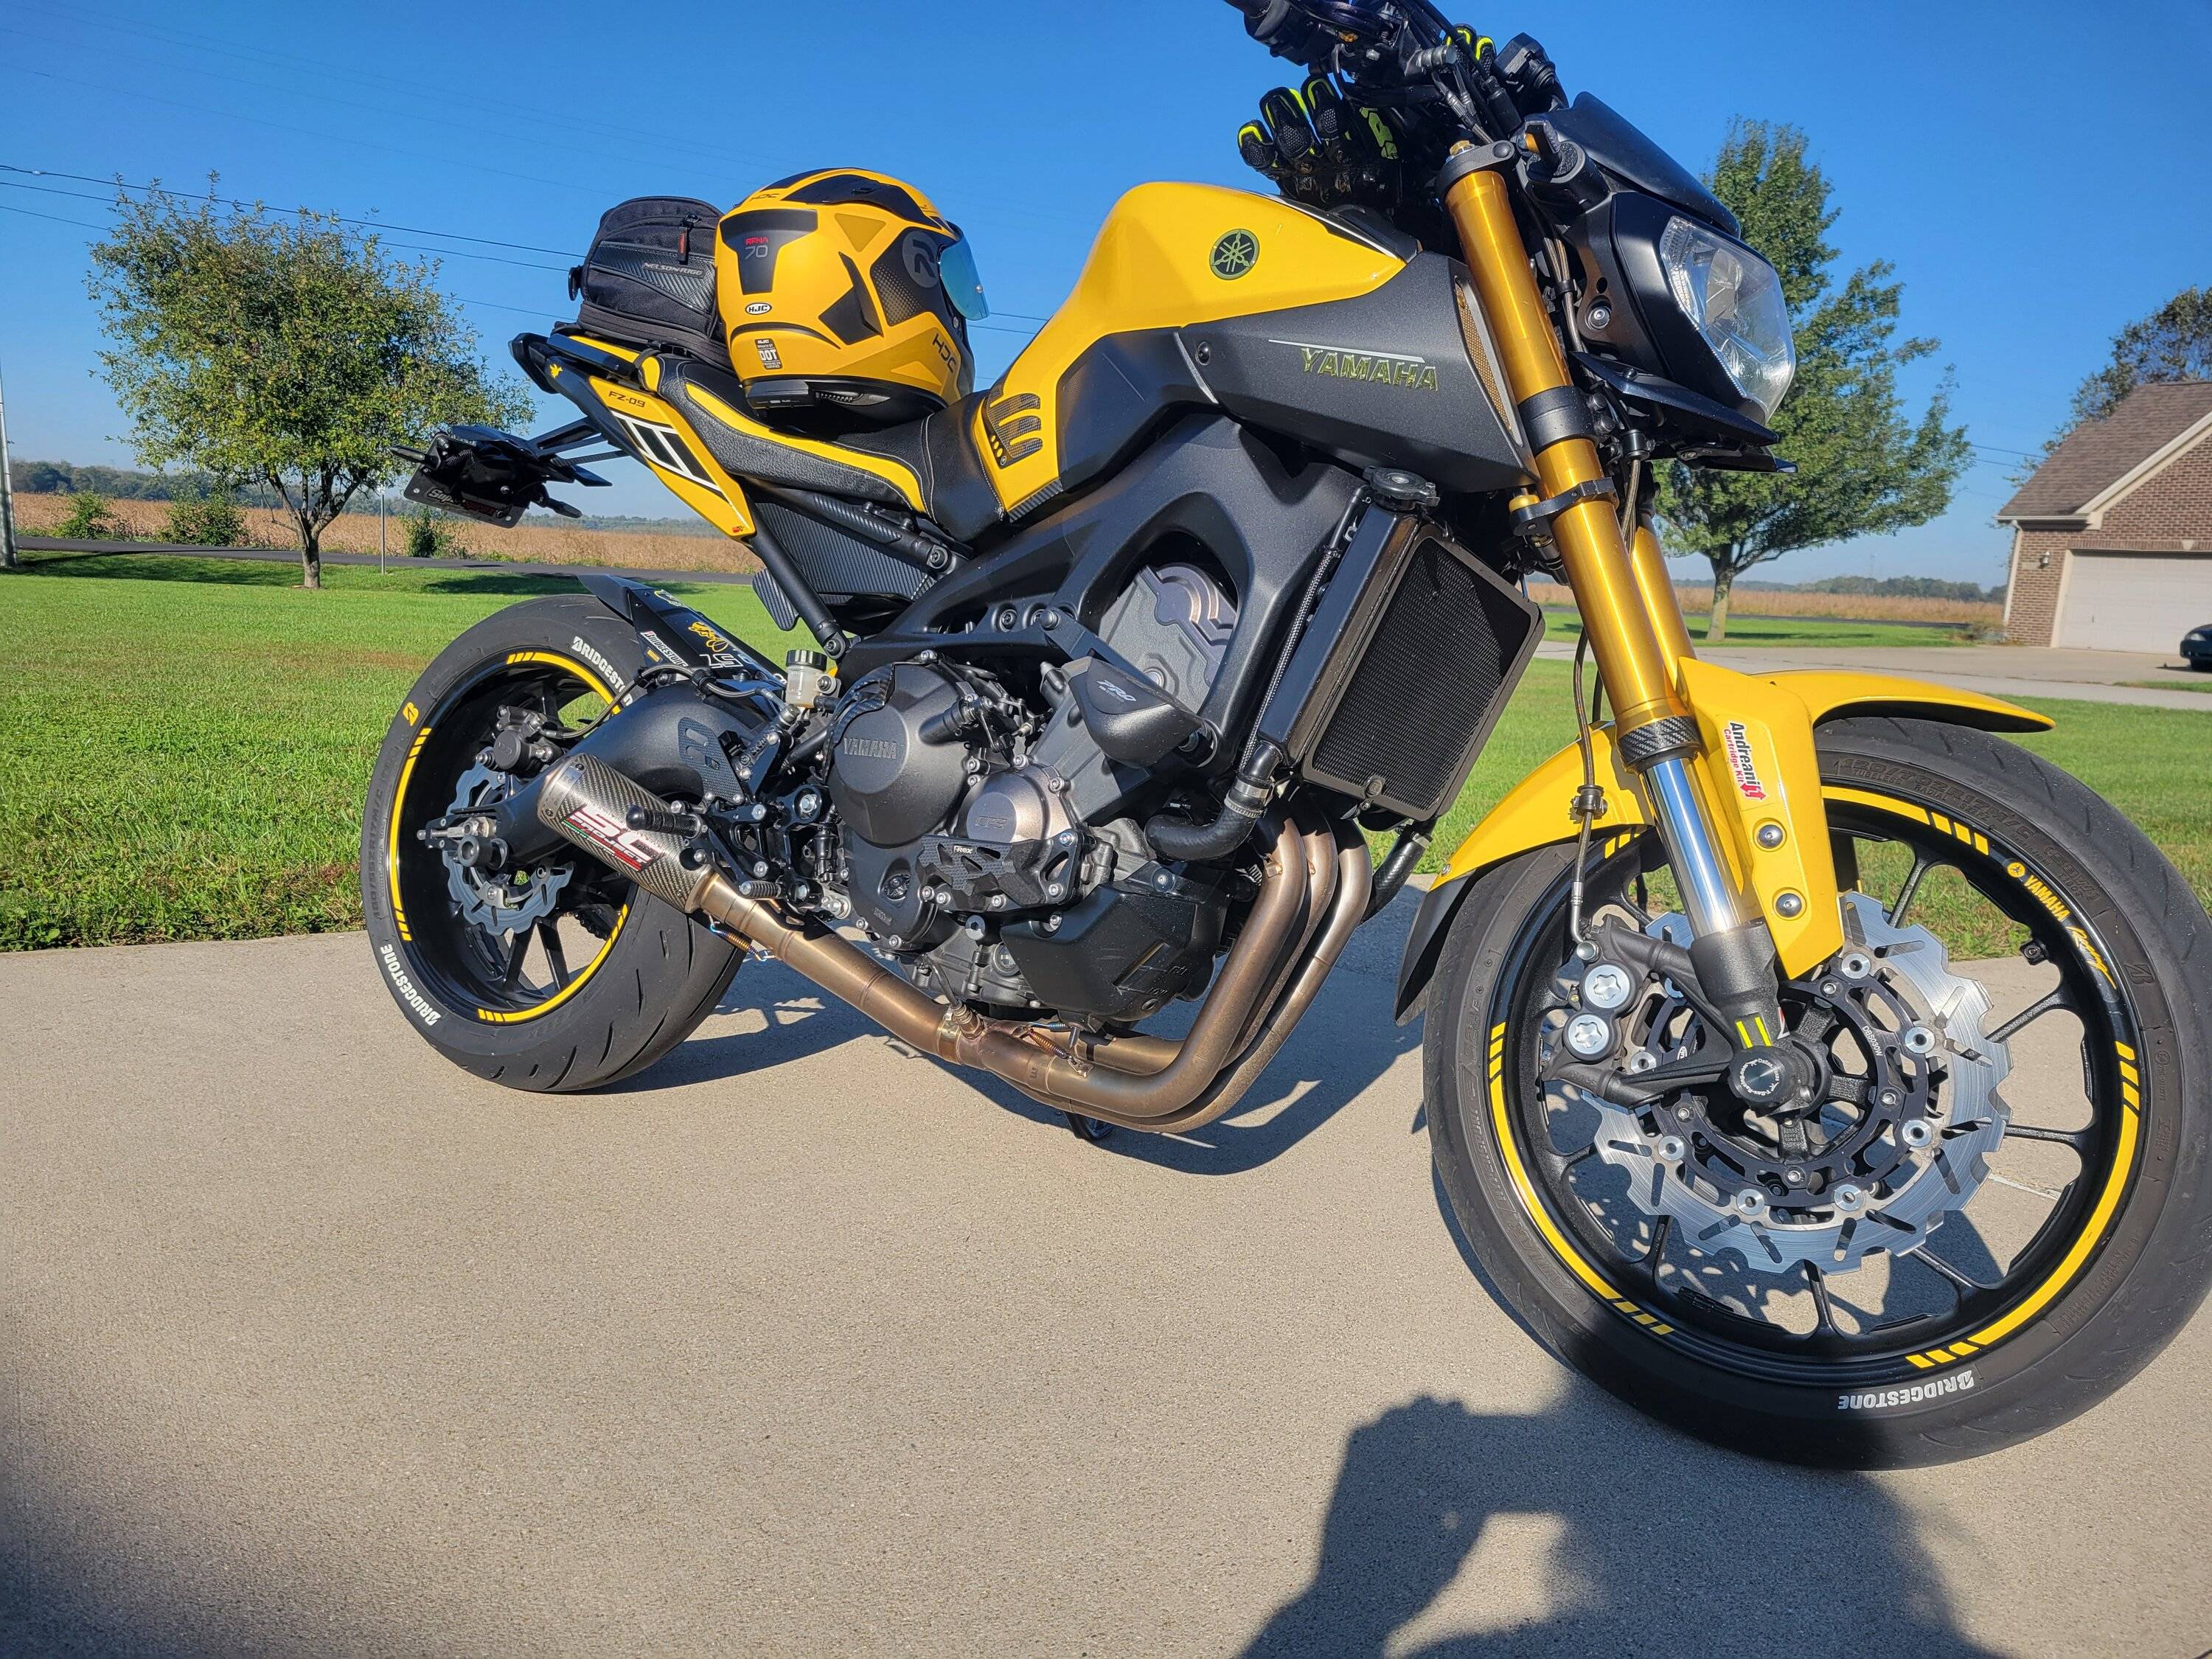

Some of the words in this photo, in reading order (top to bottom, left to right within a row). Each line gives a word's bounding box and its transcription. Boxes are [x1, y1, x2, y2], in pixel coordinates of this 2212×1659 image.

[644, 262, 703, 276] NELSON-RIGG
[745, 246, 768, 259] 70
[748, 305, 768, 313] HJC
[758, 349, 778, 361] DOT
[932, 333, 956, 372] HJC
[1301, 347, 1439, 392] YAMAHA
[608, 391, 646, 408] FZ-09
[844, 737, 897, 759] YAMAHA
[1724, 728, 1739, 768] Cartridge
[1736, 771, 1745, 782] Kit
[1730, 722, 1760, 785] Andreani
[1852, 768, 1903, 786] TUBELESS
[1913, 784, 1949, 802] RADIAL
[569, 814, 647, 864] PROJECT
[573, 804, 663, 861] SC
[2023, 874, 2071, 922] YAMAHA
[380, 944, 442, 1026] BRIDGESTONE
[1863, 1026, 1883, 1056] DB5030W
[1837, 1370, 1975, 1410] BRIDGESTONE
